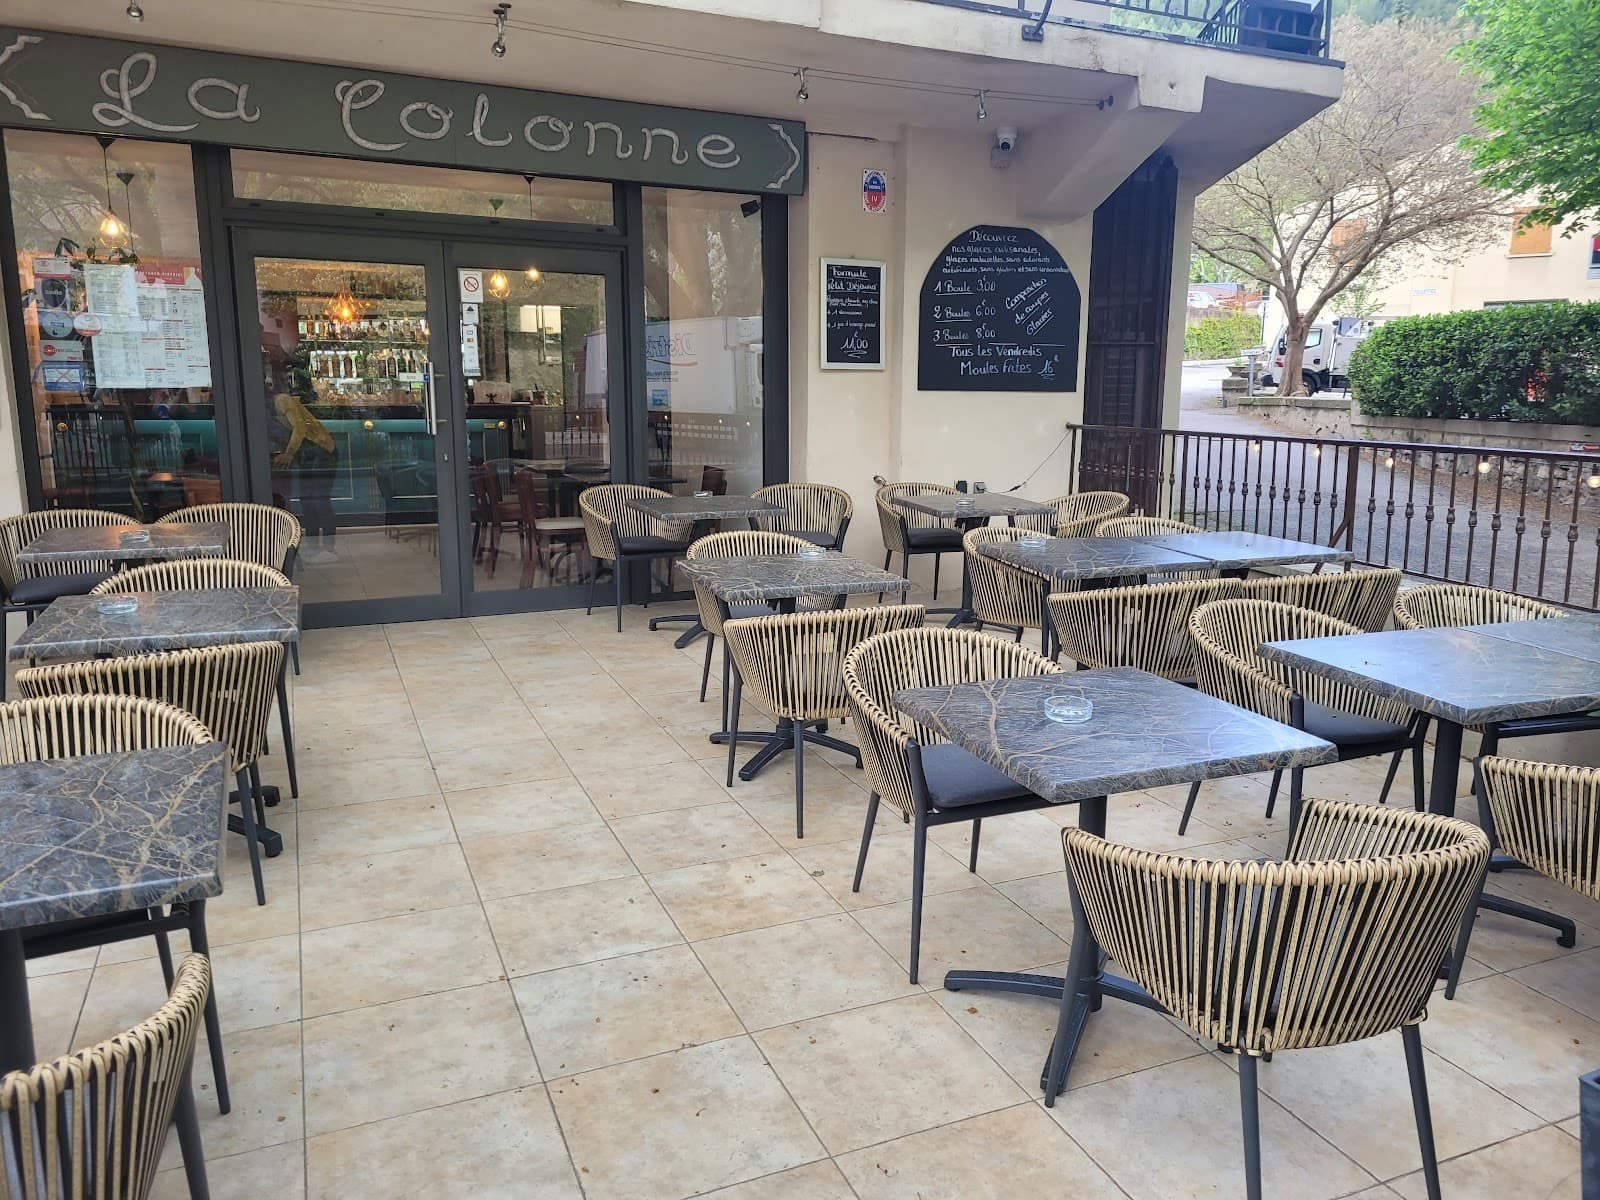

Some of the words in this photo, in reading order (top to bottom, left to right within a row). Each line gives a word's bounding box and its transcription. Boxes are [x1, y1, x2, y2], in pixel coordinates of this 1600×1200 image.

[93, 52, 262, 133] La
[334, 79, 742, 169] Colonne
[829, 265, 868, 278] Formule
[944, 279, 971, 292] Boule
[933, 305, 942, 319] 2
[933, 329, 941, 342] 3
[948, 346, 974, 357] Tous
[996, 346, 1042, 357] Vendredis
[960, 360, 999, 376] Moules
